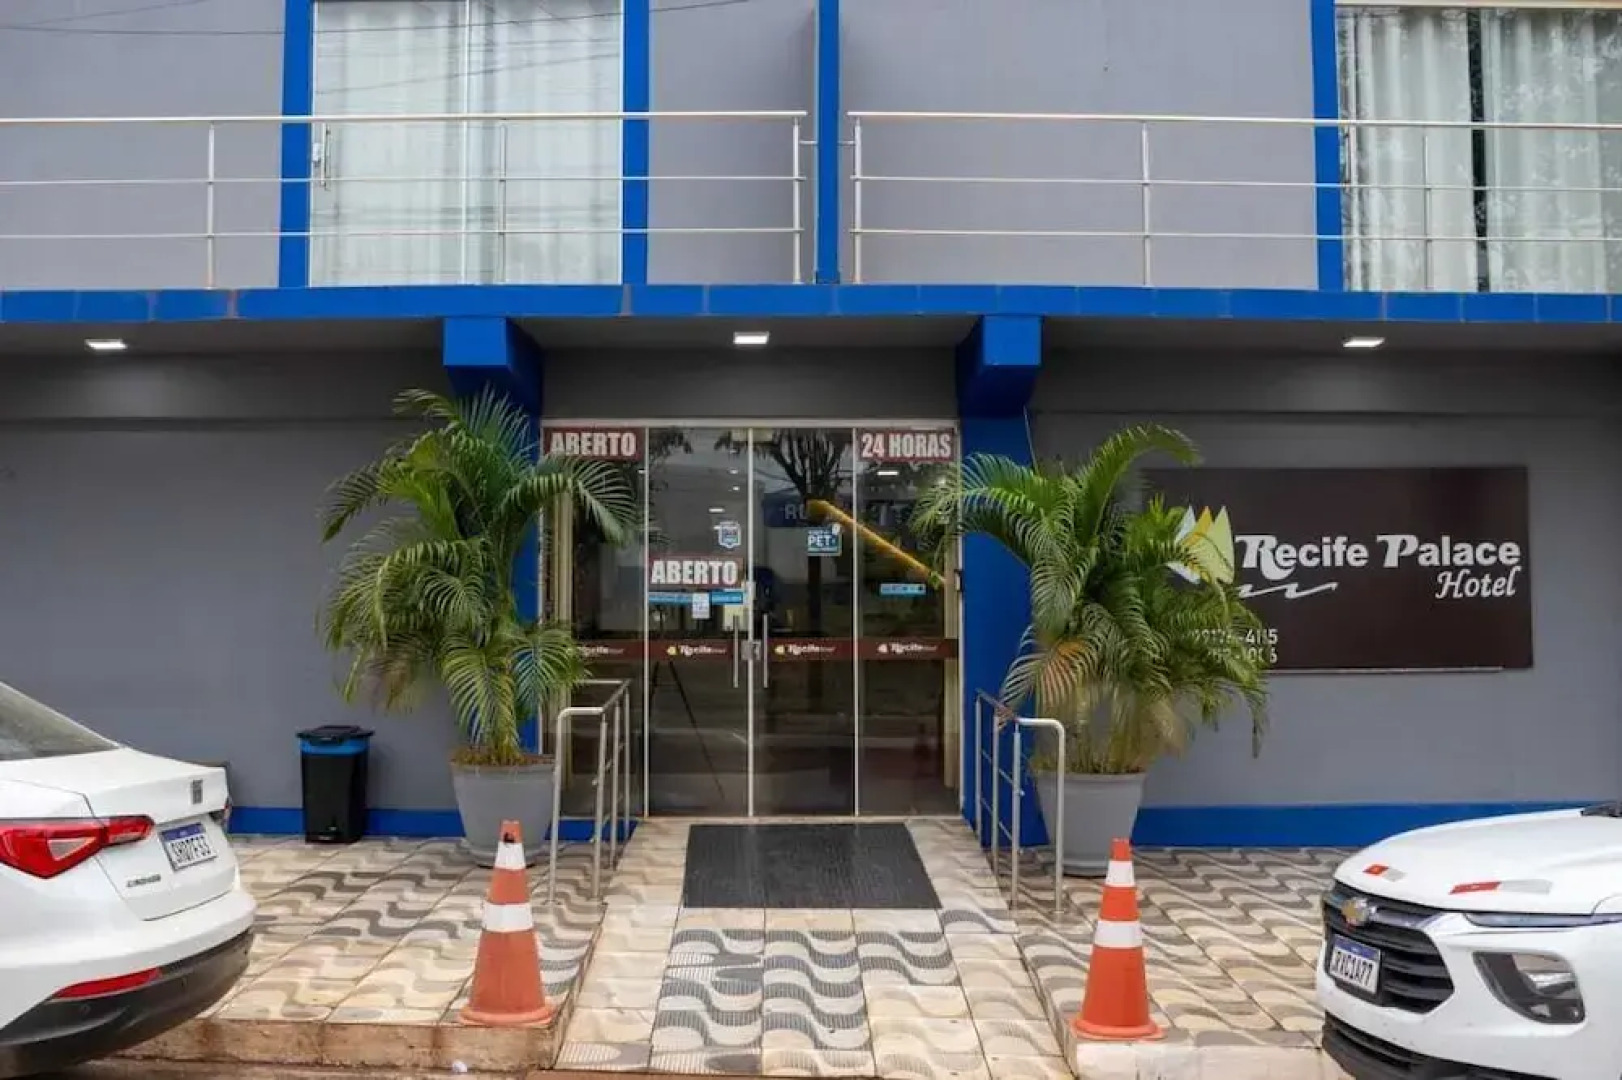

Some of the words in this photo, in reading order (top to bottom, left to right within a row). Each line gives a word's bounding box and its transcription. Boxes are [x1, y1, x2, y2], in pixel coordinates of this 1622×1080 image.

[550, 432, 637, 457] ABERTO
[862, 433, 885, 458] 24
[888, 433, 952, 458] HORAS
[1235, 534, 1369, 581] Recife
[1376, 534, 1521, 568] Palace
[650, 559, 739, 585] ABERTO
[1435, 566, 1523, 599] Hotel
